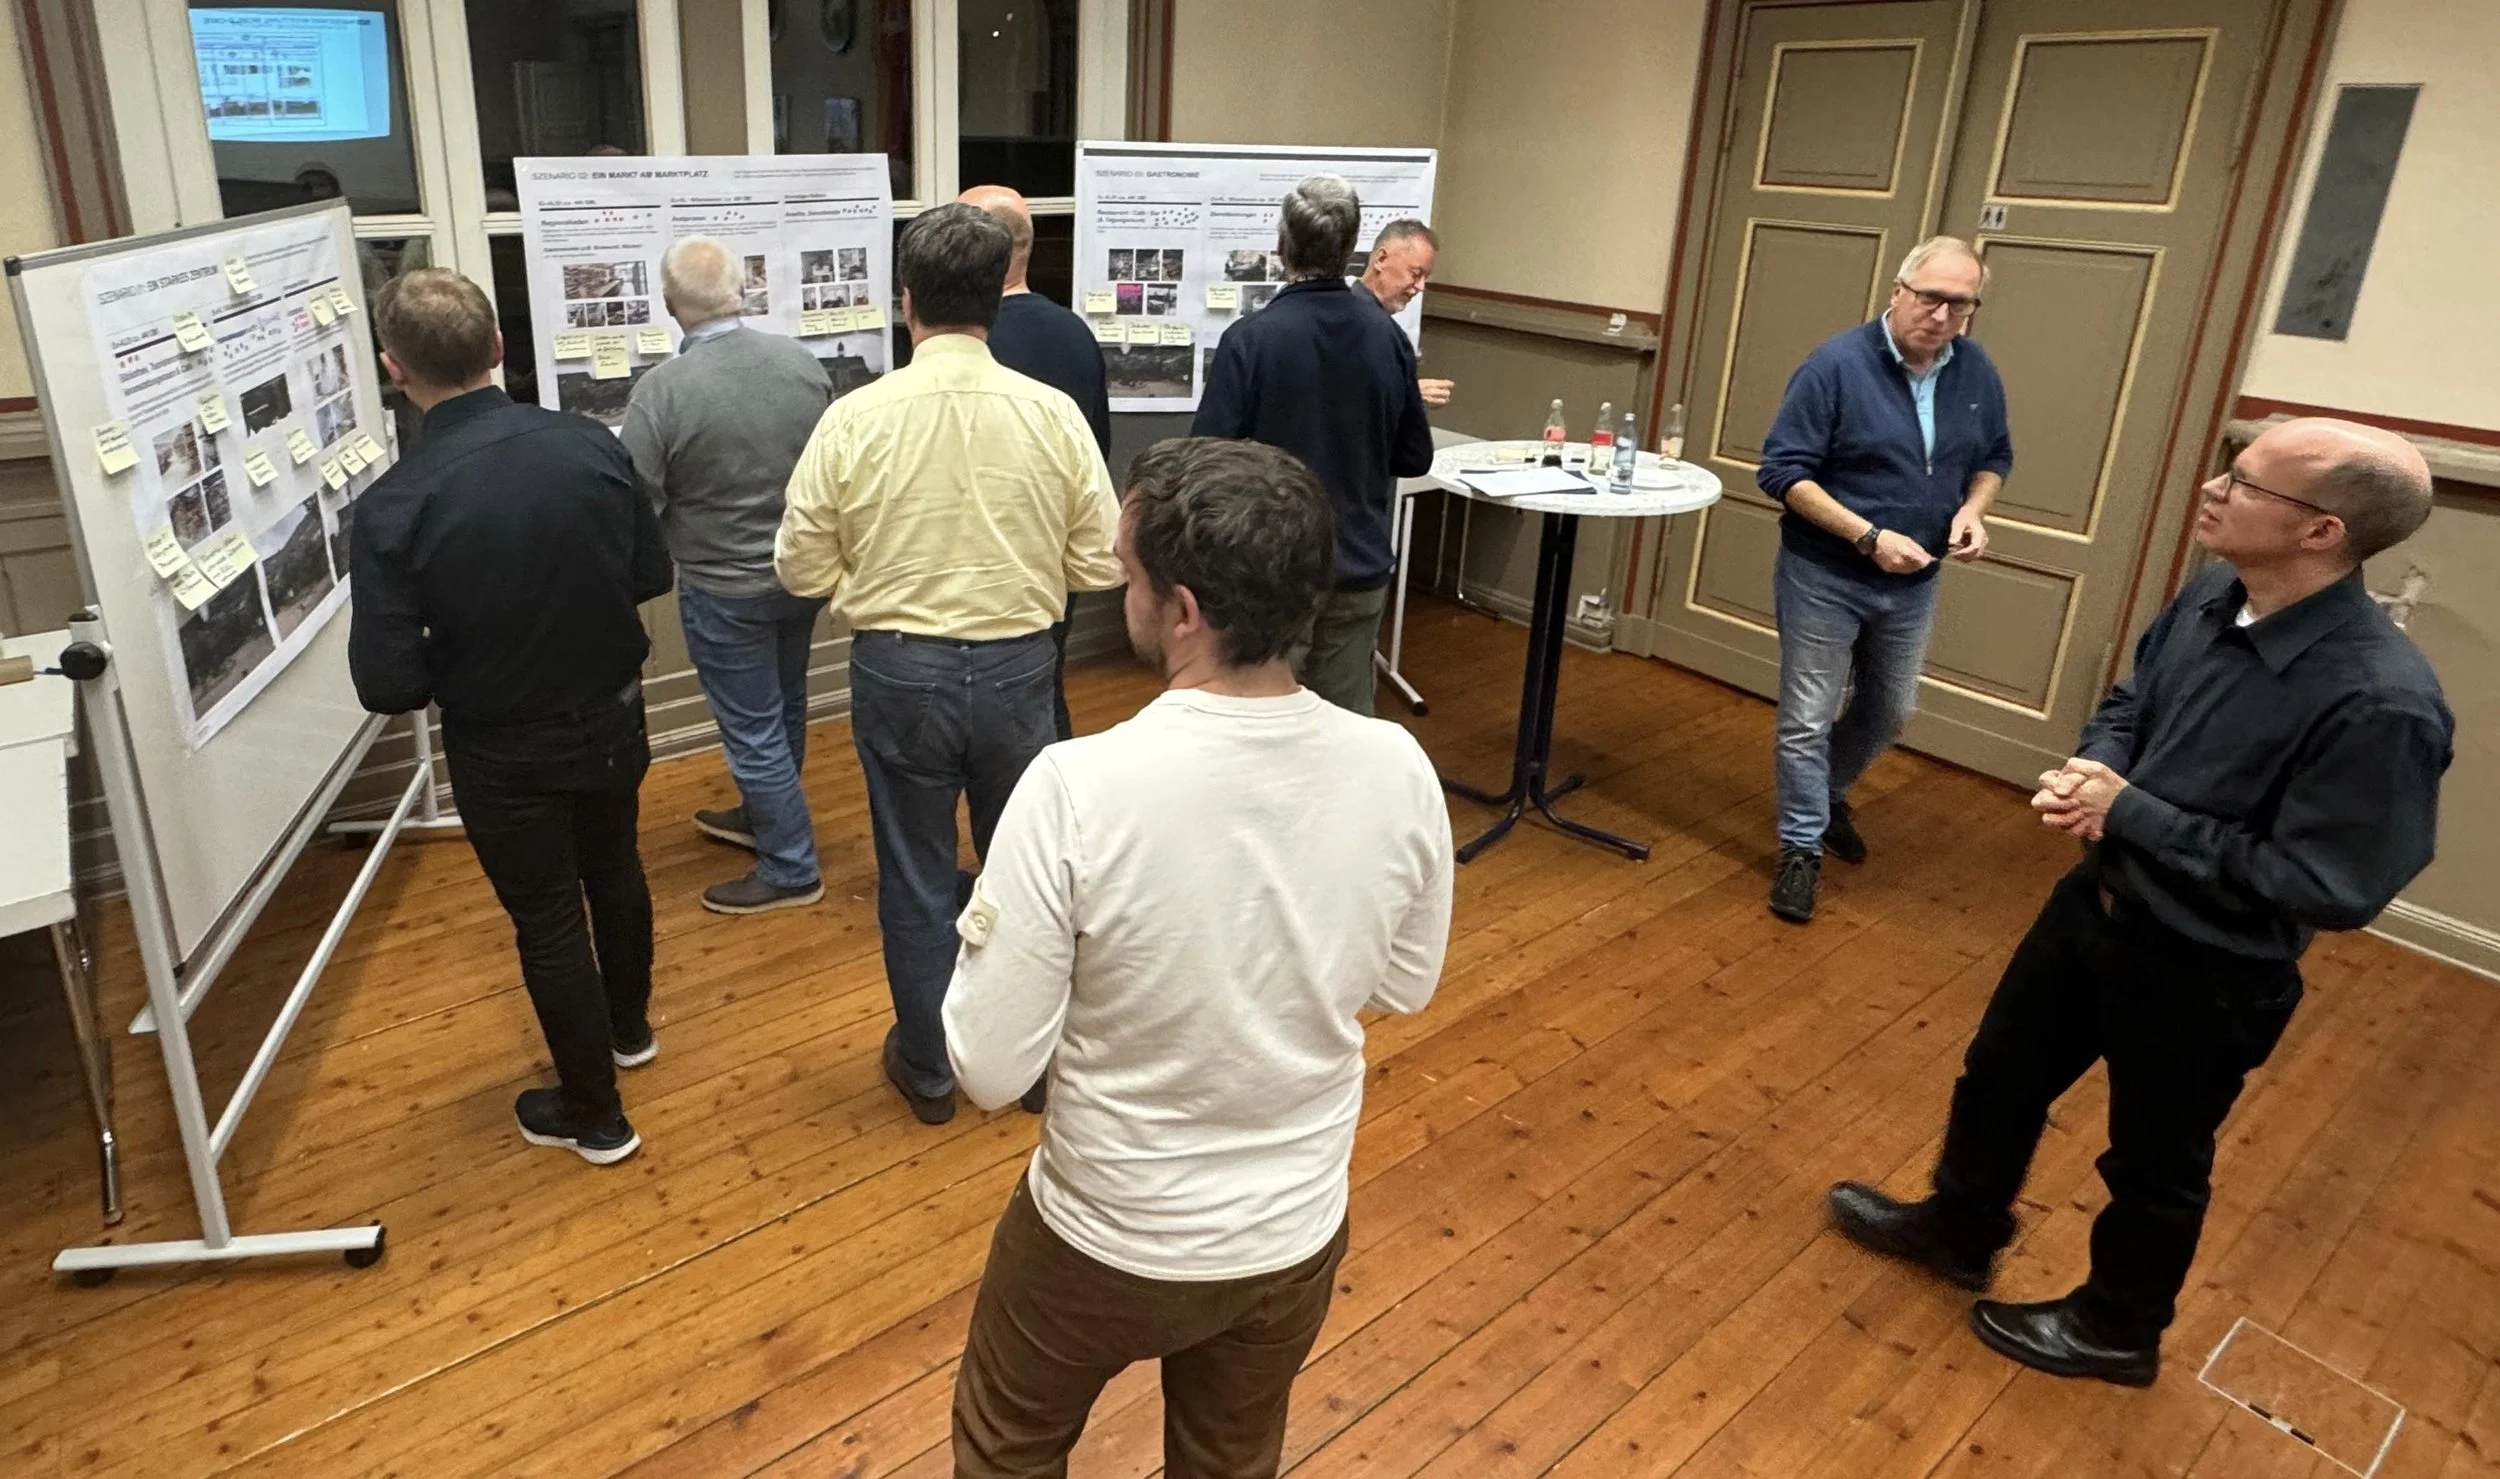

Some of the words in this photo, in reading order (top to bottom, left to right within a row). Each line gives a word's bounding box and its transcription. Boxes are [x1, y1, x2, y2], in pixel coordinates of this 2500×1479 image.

[592, 171, 606, 179] EIN
[609, 171, 638, 179] MARKT
[655, 170, 709, 178] MARKTPLATZ
